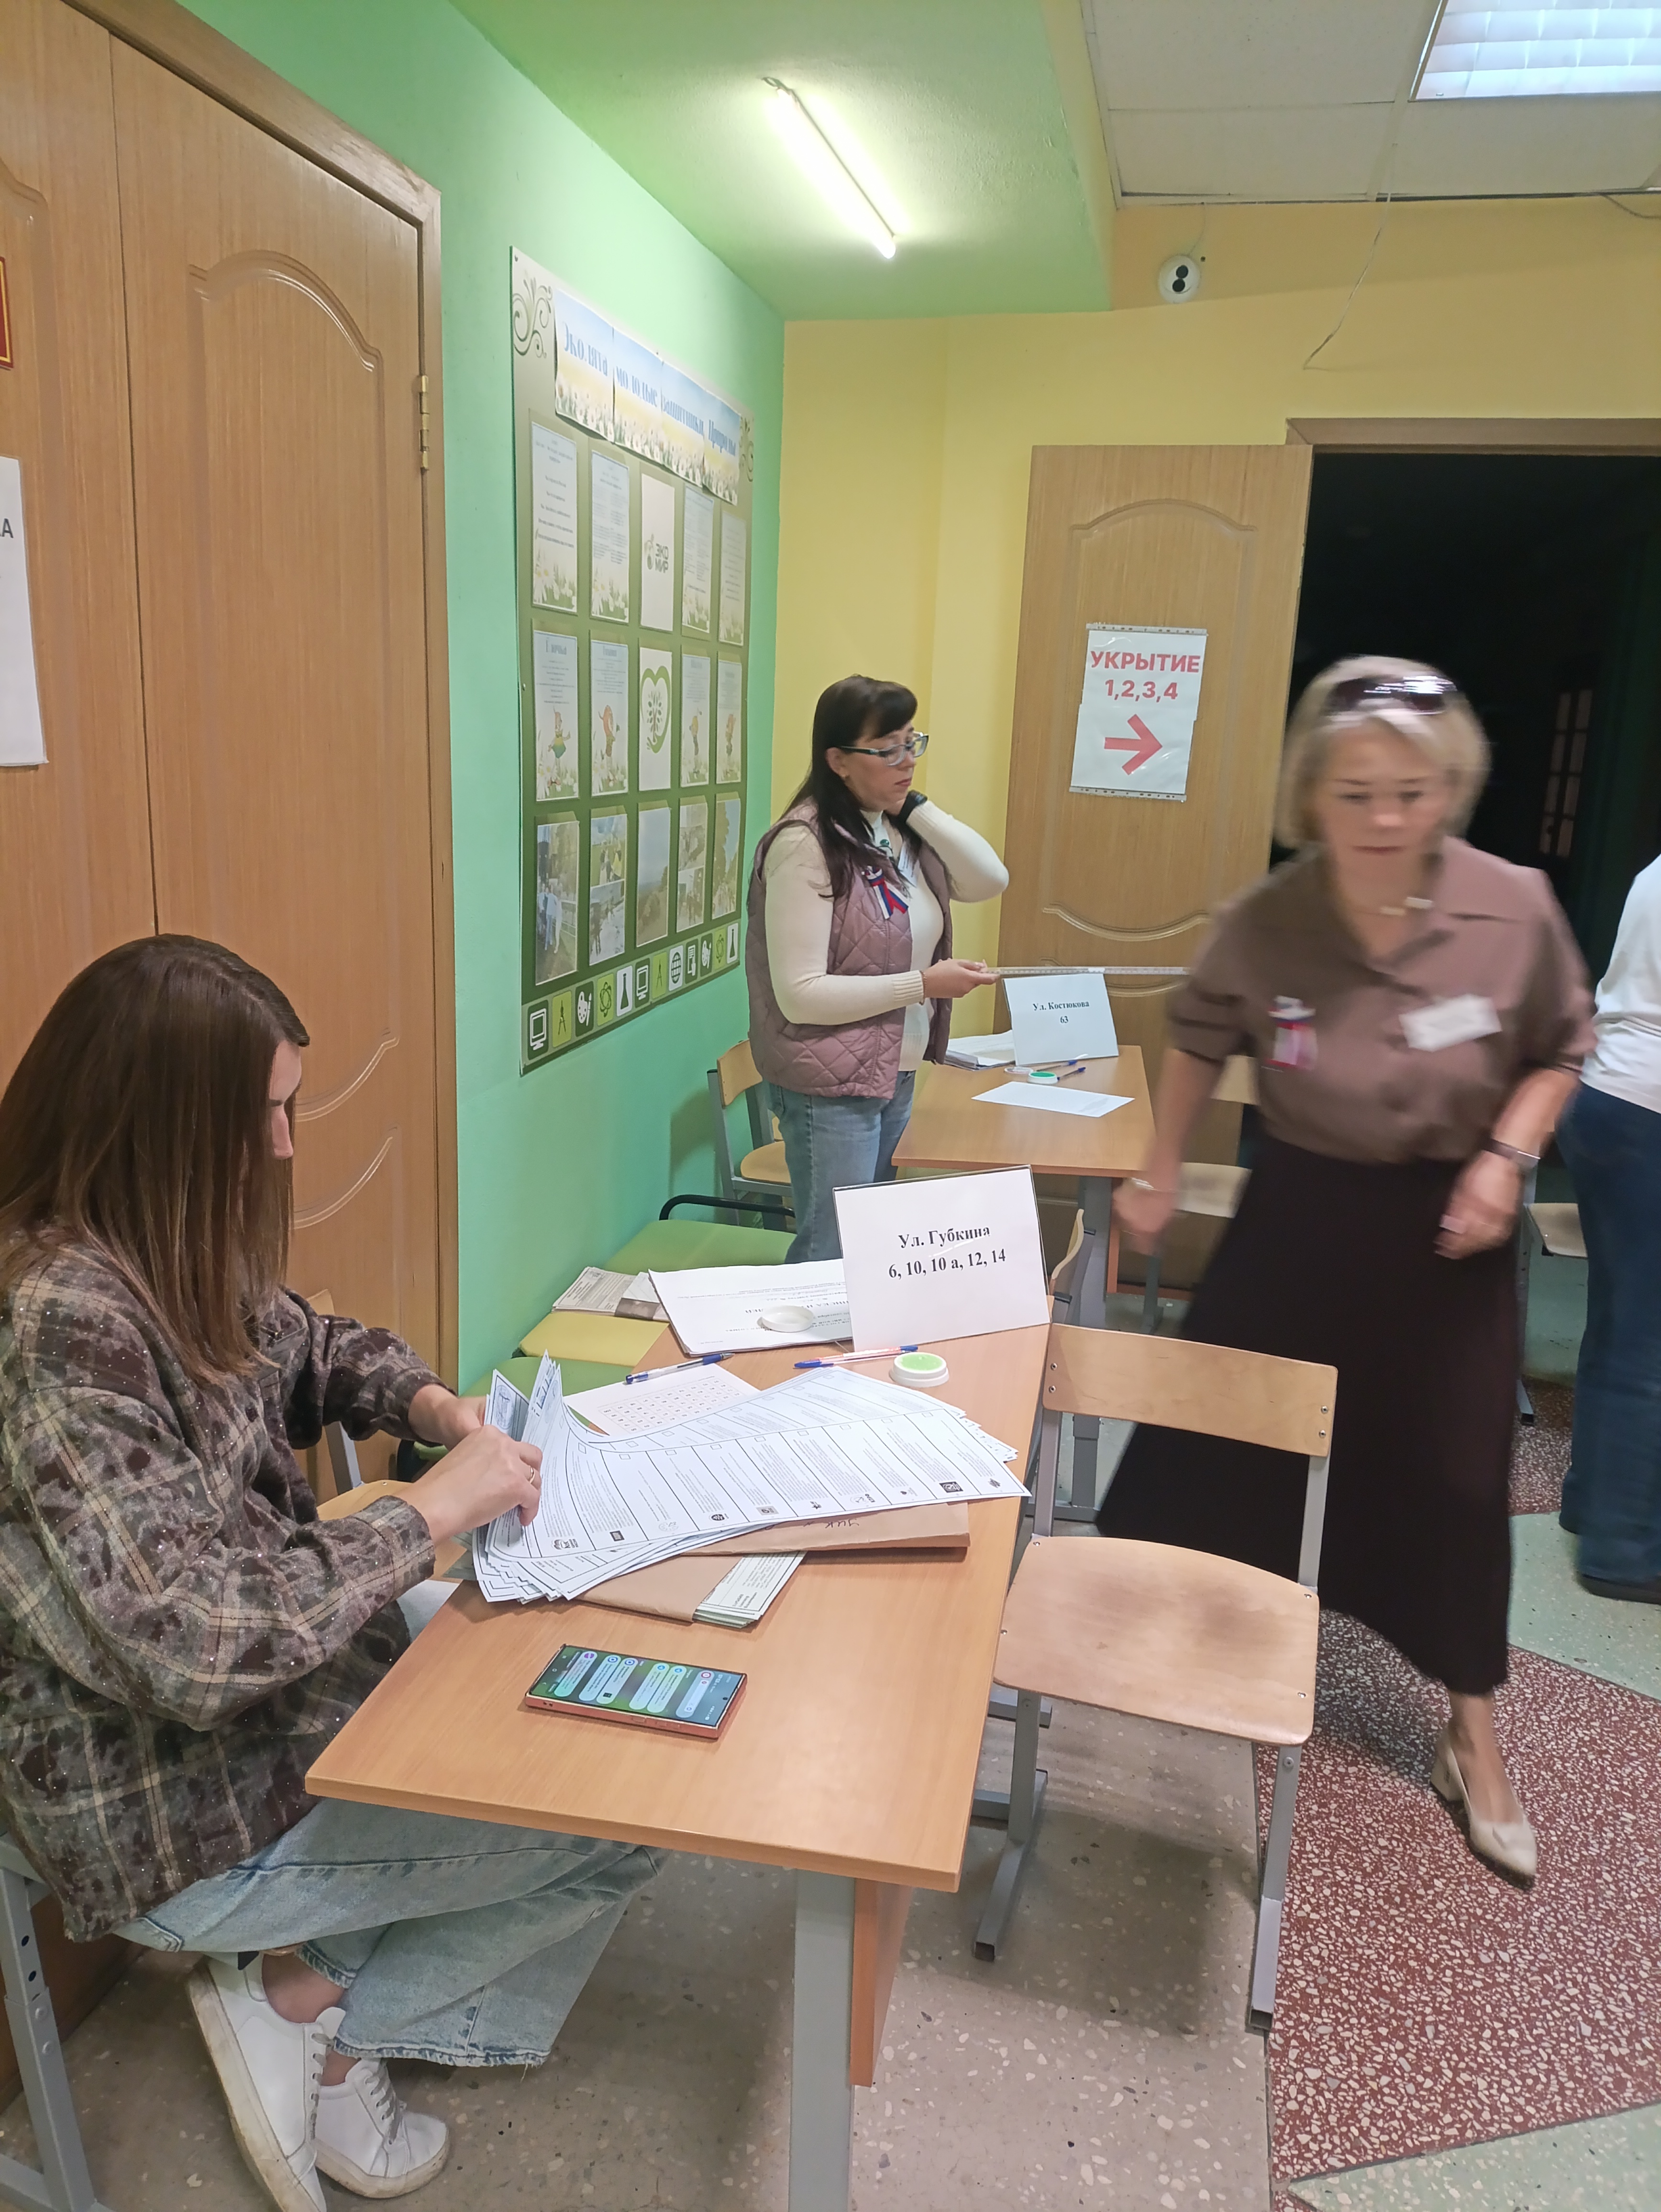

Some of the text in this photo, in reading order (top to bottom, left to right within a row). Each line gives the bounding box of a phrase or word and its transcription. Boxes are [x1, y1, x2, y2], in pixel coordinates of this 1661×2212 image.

[1090, 651, 1201, 673] УКРЫТИЕ
[1105, 679, 1178, 703] 1,2,3,4
[1048, 1001, 1089, 1010] Костюкова
[897, 1226, 991, 1249] Ул. Губкина
[888, 1248, 1006, 1280] 6, 10, 10 а, 12, 14
